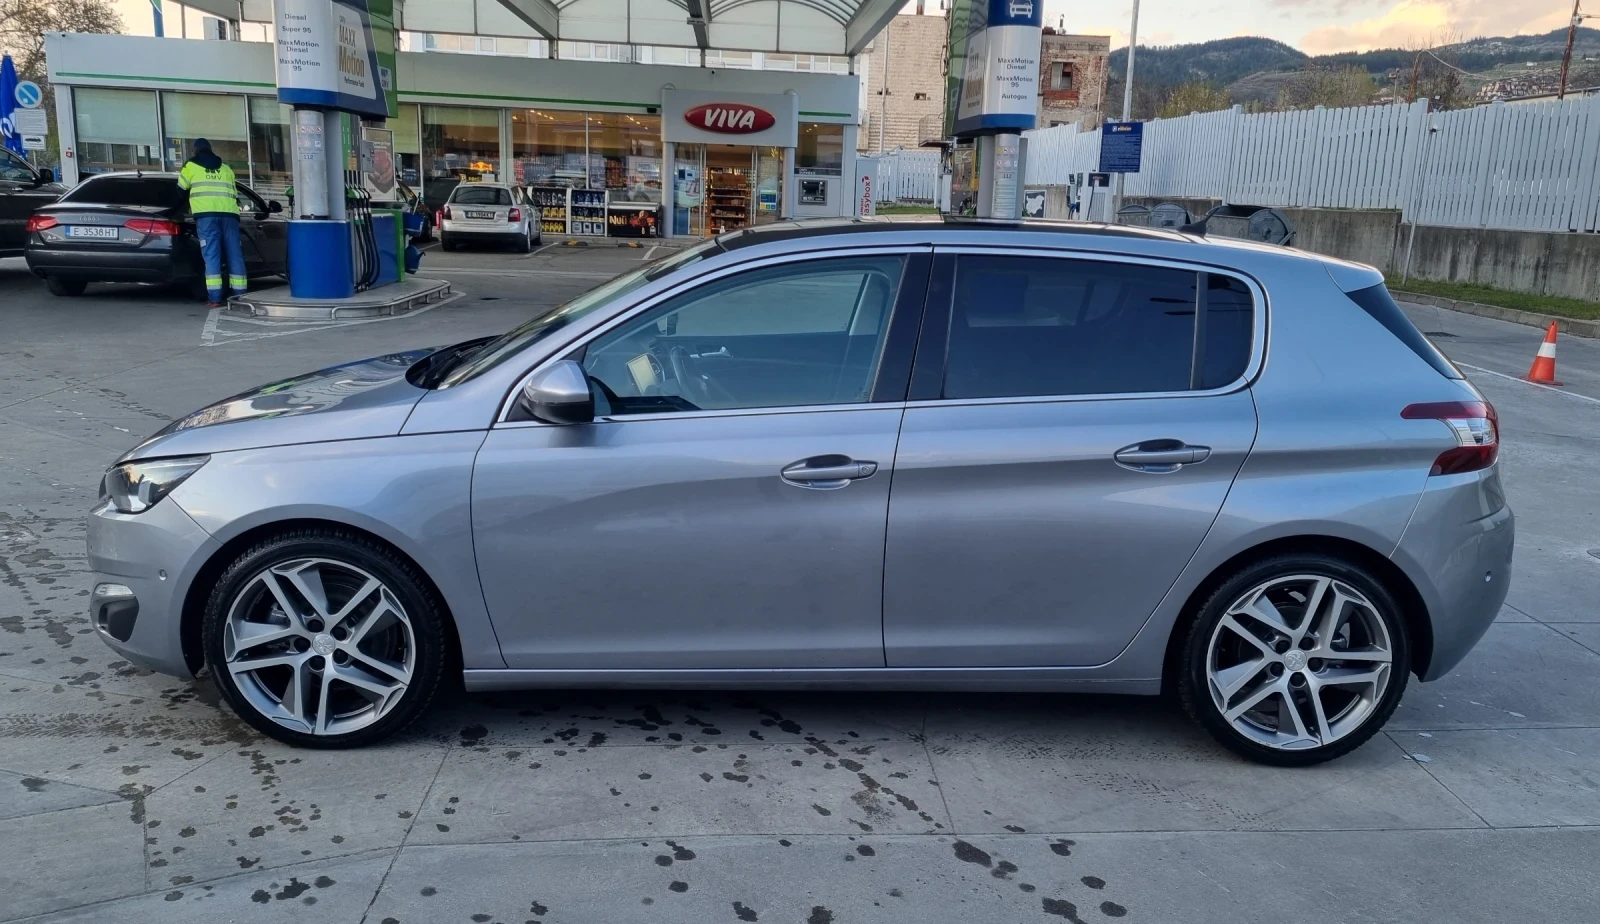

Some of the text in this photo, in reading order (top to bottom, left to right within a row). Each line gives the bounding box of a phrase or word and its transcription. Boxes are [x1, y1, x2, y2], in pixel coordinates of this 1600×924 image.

[282, 25, 300, 33] Super
[339, 24, 356, 47] MAXX
[278, 39, 320, 48] MaxxMotion
[279, 58, 321, 67] MaxxMotion
[339, 45, 365, 78] Motion
[704, 107, 756, 129] VIVA
[73, 227, 80, 236] E
